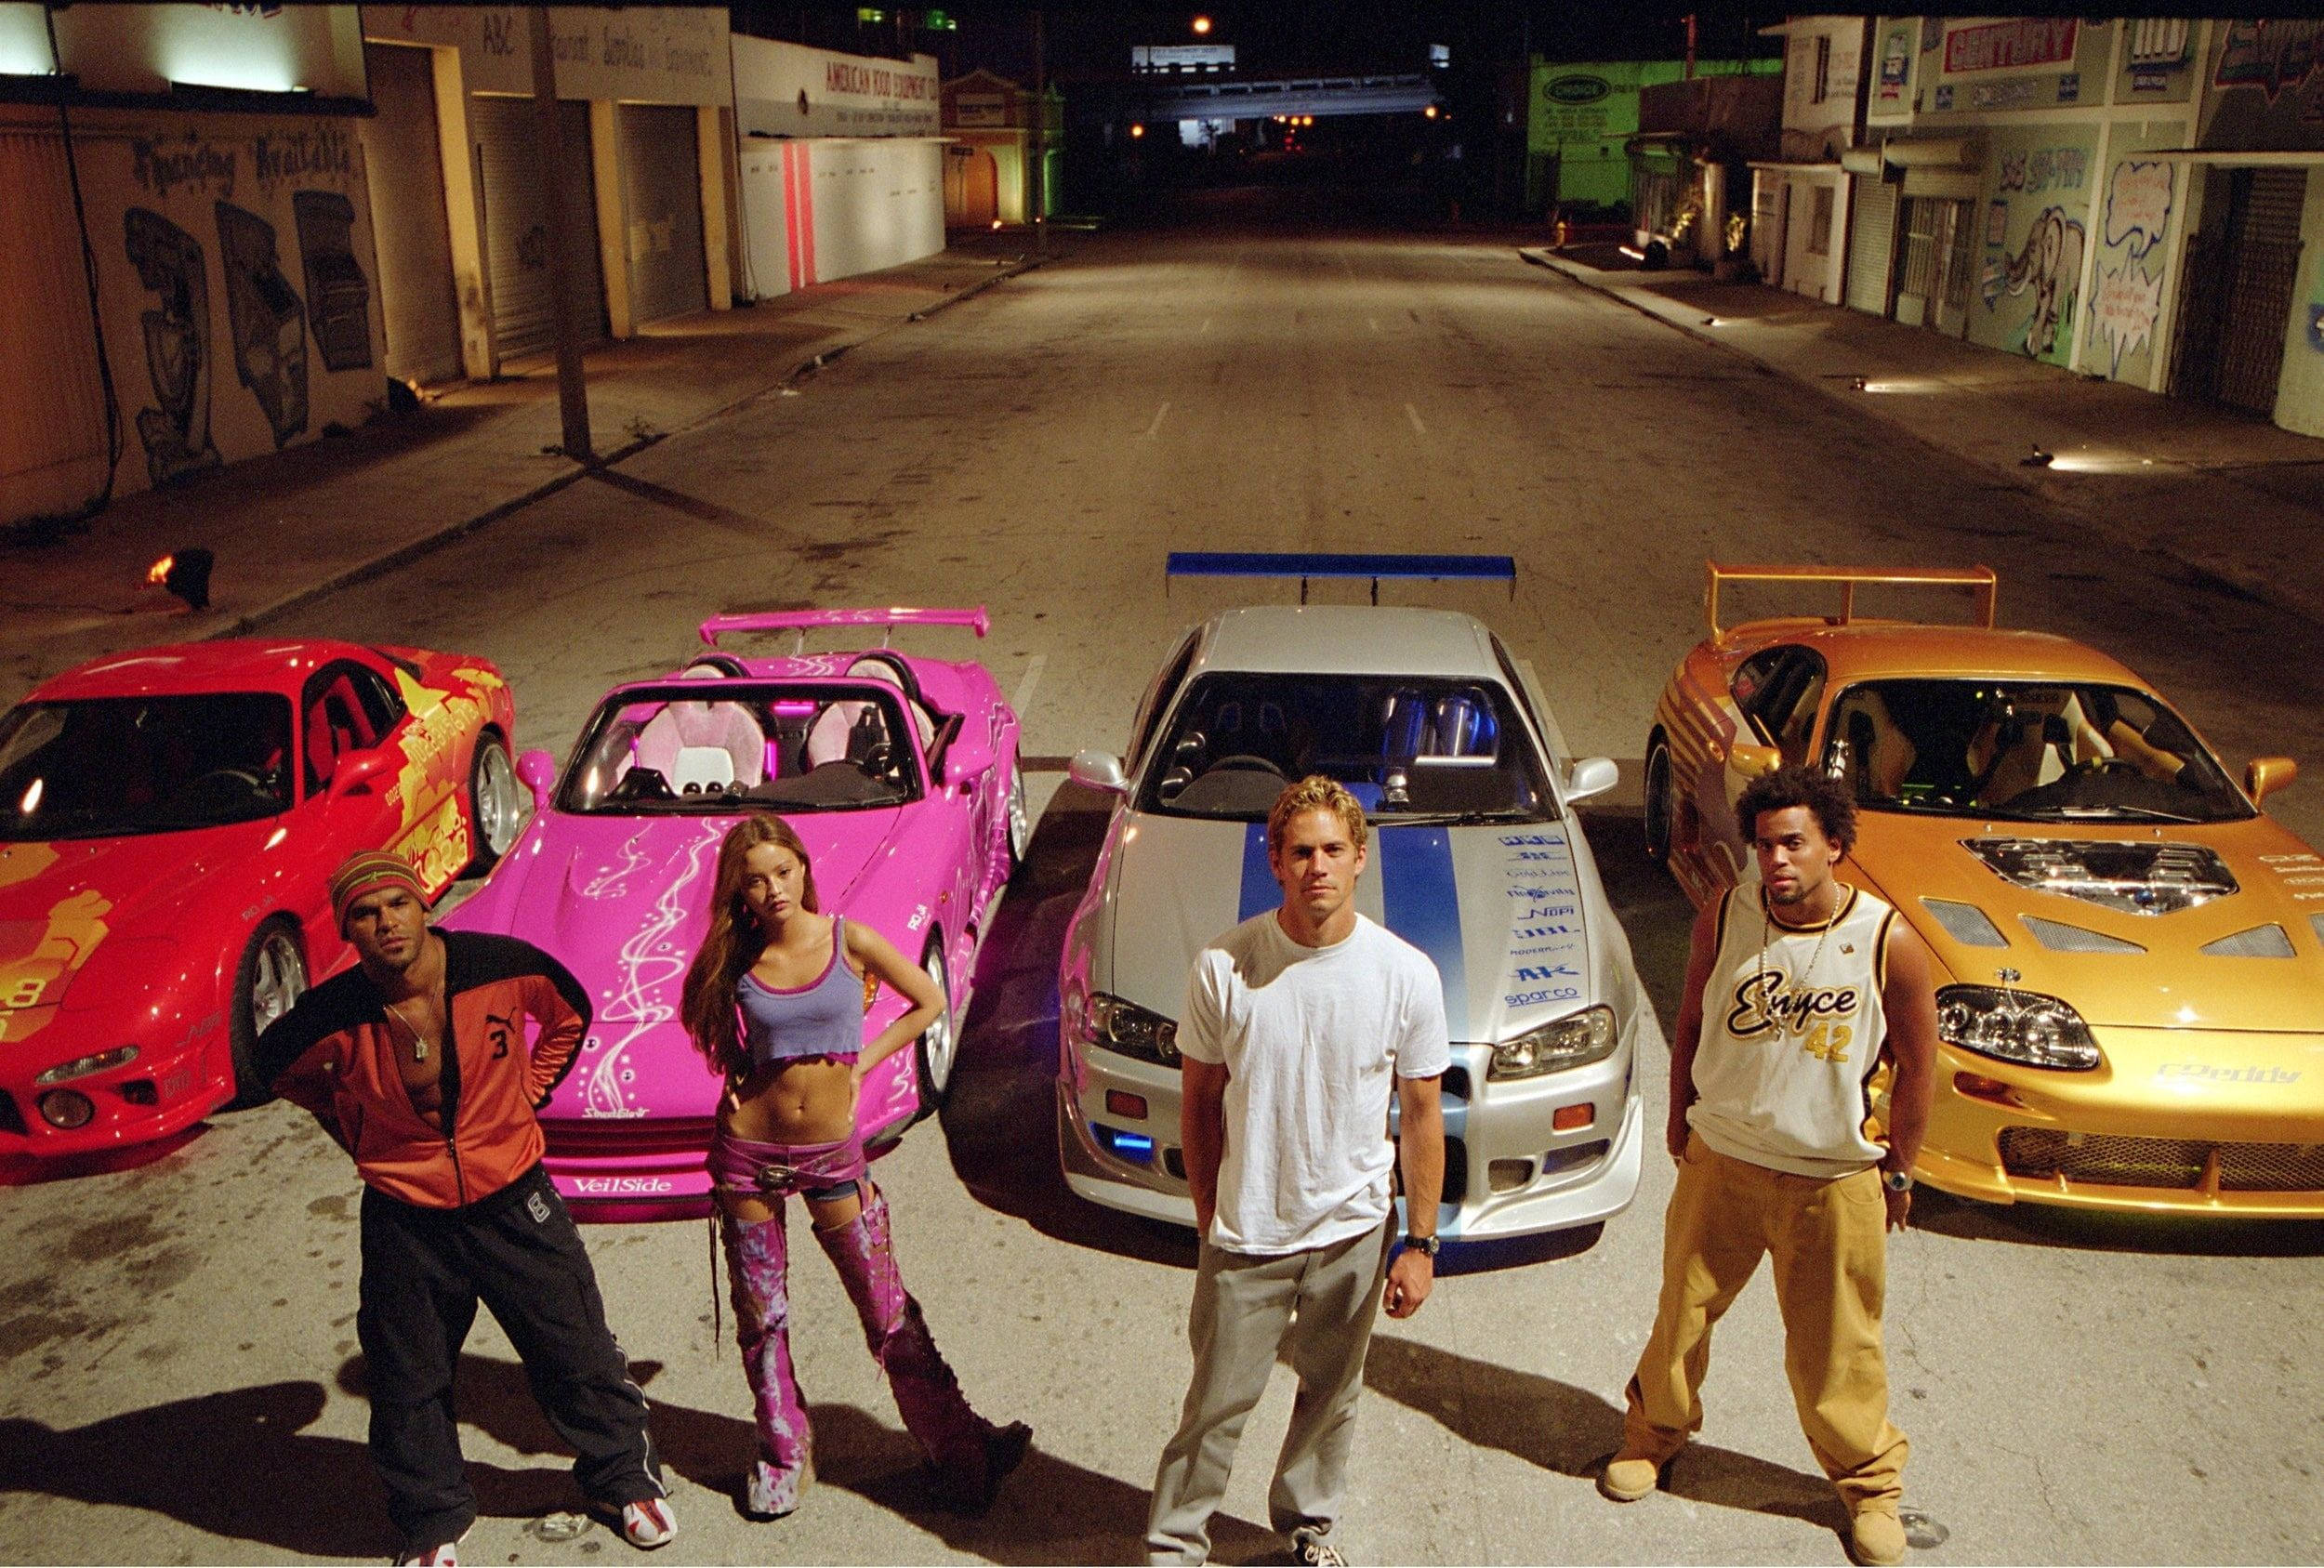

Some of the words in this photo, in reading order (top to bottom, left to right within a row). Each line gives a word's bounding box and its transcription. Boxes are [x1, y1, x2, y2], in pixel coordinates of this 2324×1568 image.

[484, 14, 514, 56] ABC
[1950, 20, 2073, 70] CENTURY
[825, 60, 870, 94] AMERICAN
[873, 69, 890, 97] FOOD
[1504, 988, 1578, 1007] sparco
[1727, 969, 1858, 1037] Enyce
[490, 1030, 508, 1060] 3
[1805, 1022, 1853, 1062] 42
[574, 1178, 672, 1192] VeilSide
